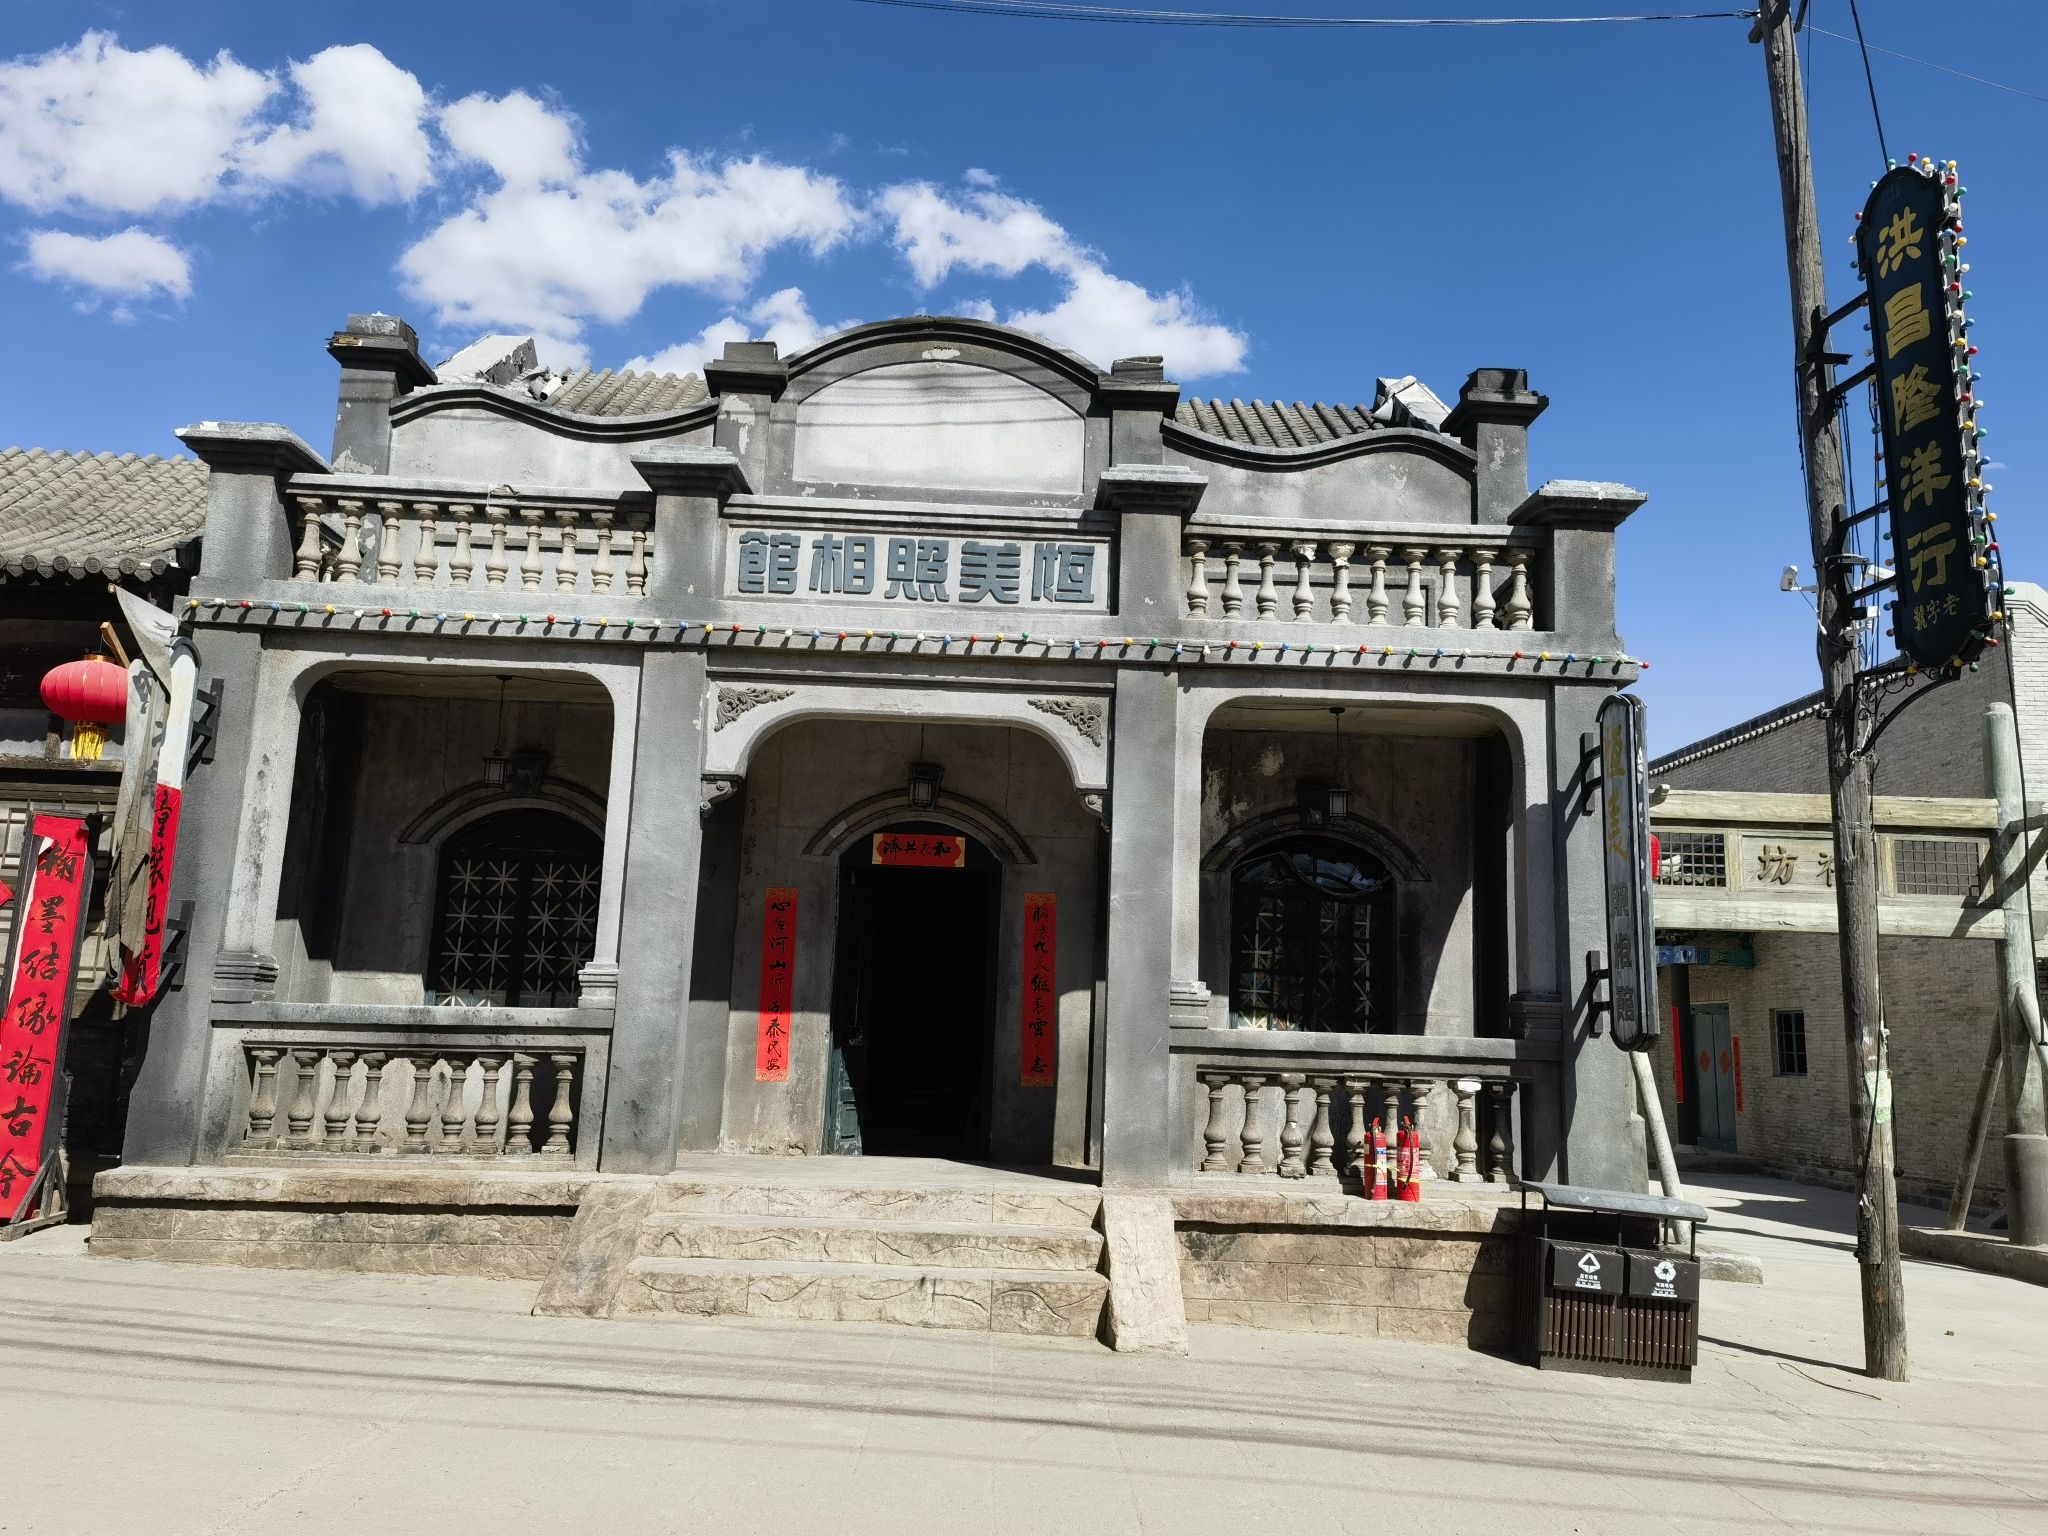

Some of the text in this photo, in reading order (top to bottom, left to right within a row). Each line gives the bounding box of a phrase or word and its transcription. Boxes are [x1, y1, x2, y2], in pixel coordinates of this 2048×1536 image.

[1876, 205, 1957, 594] 洪昌隆洋行
